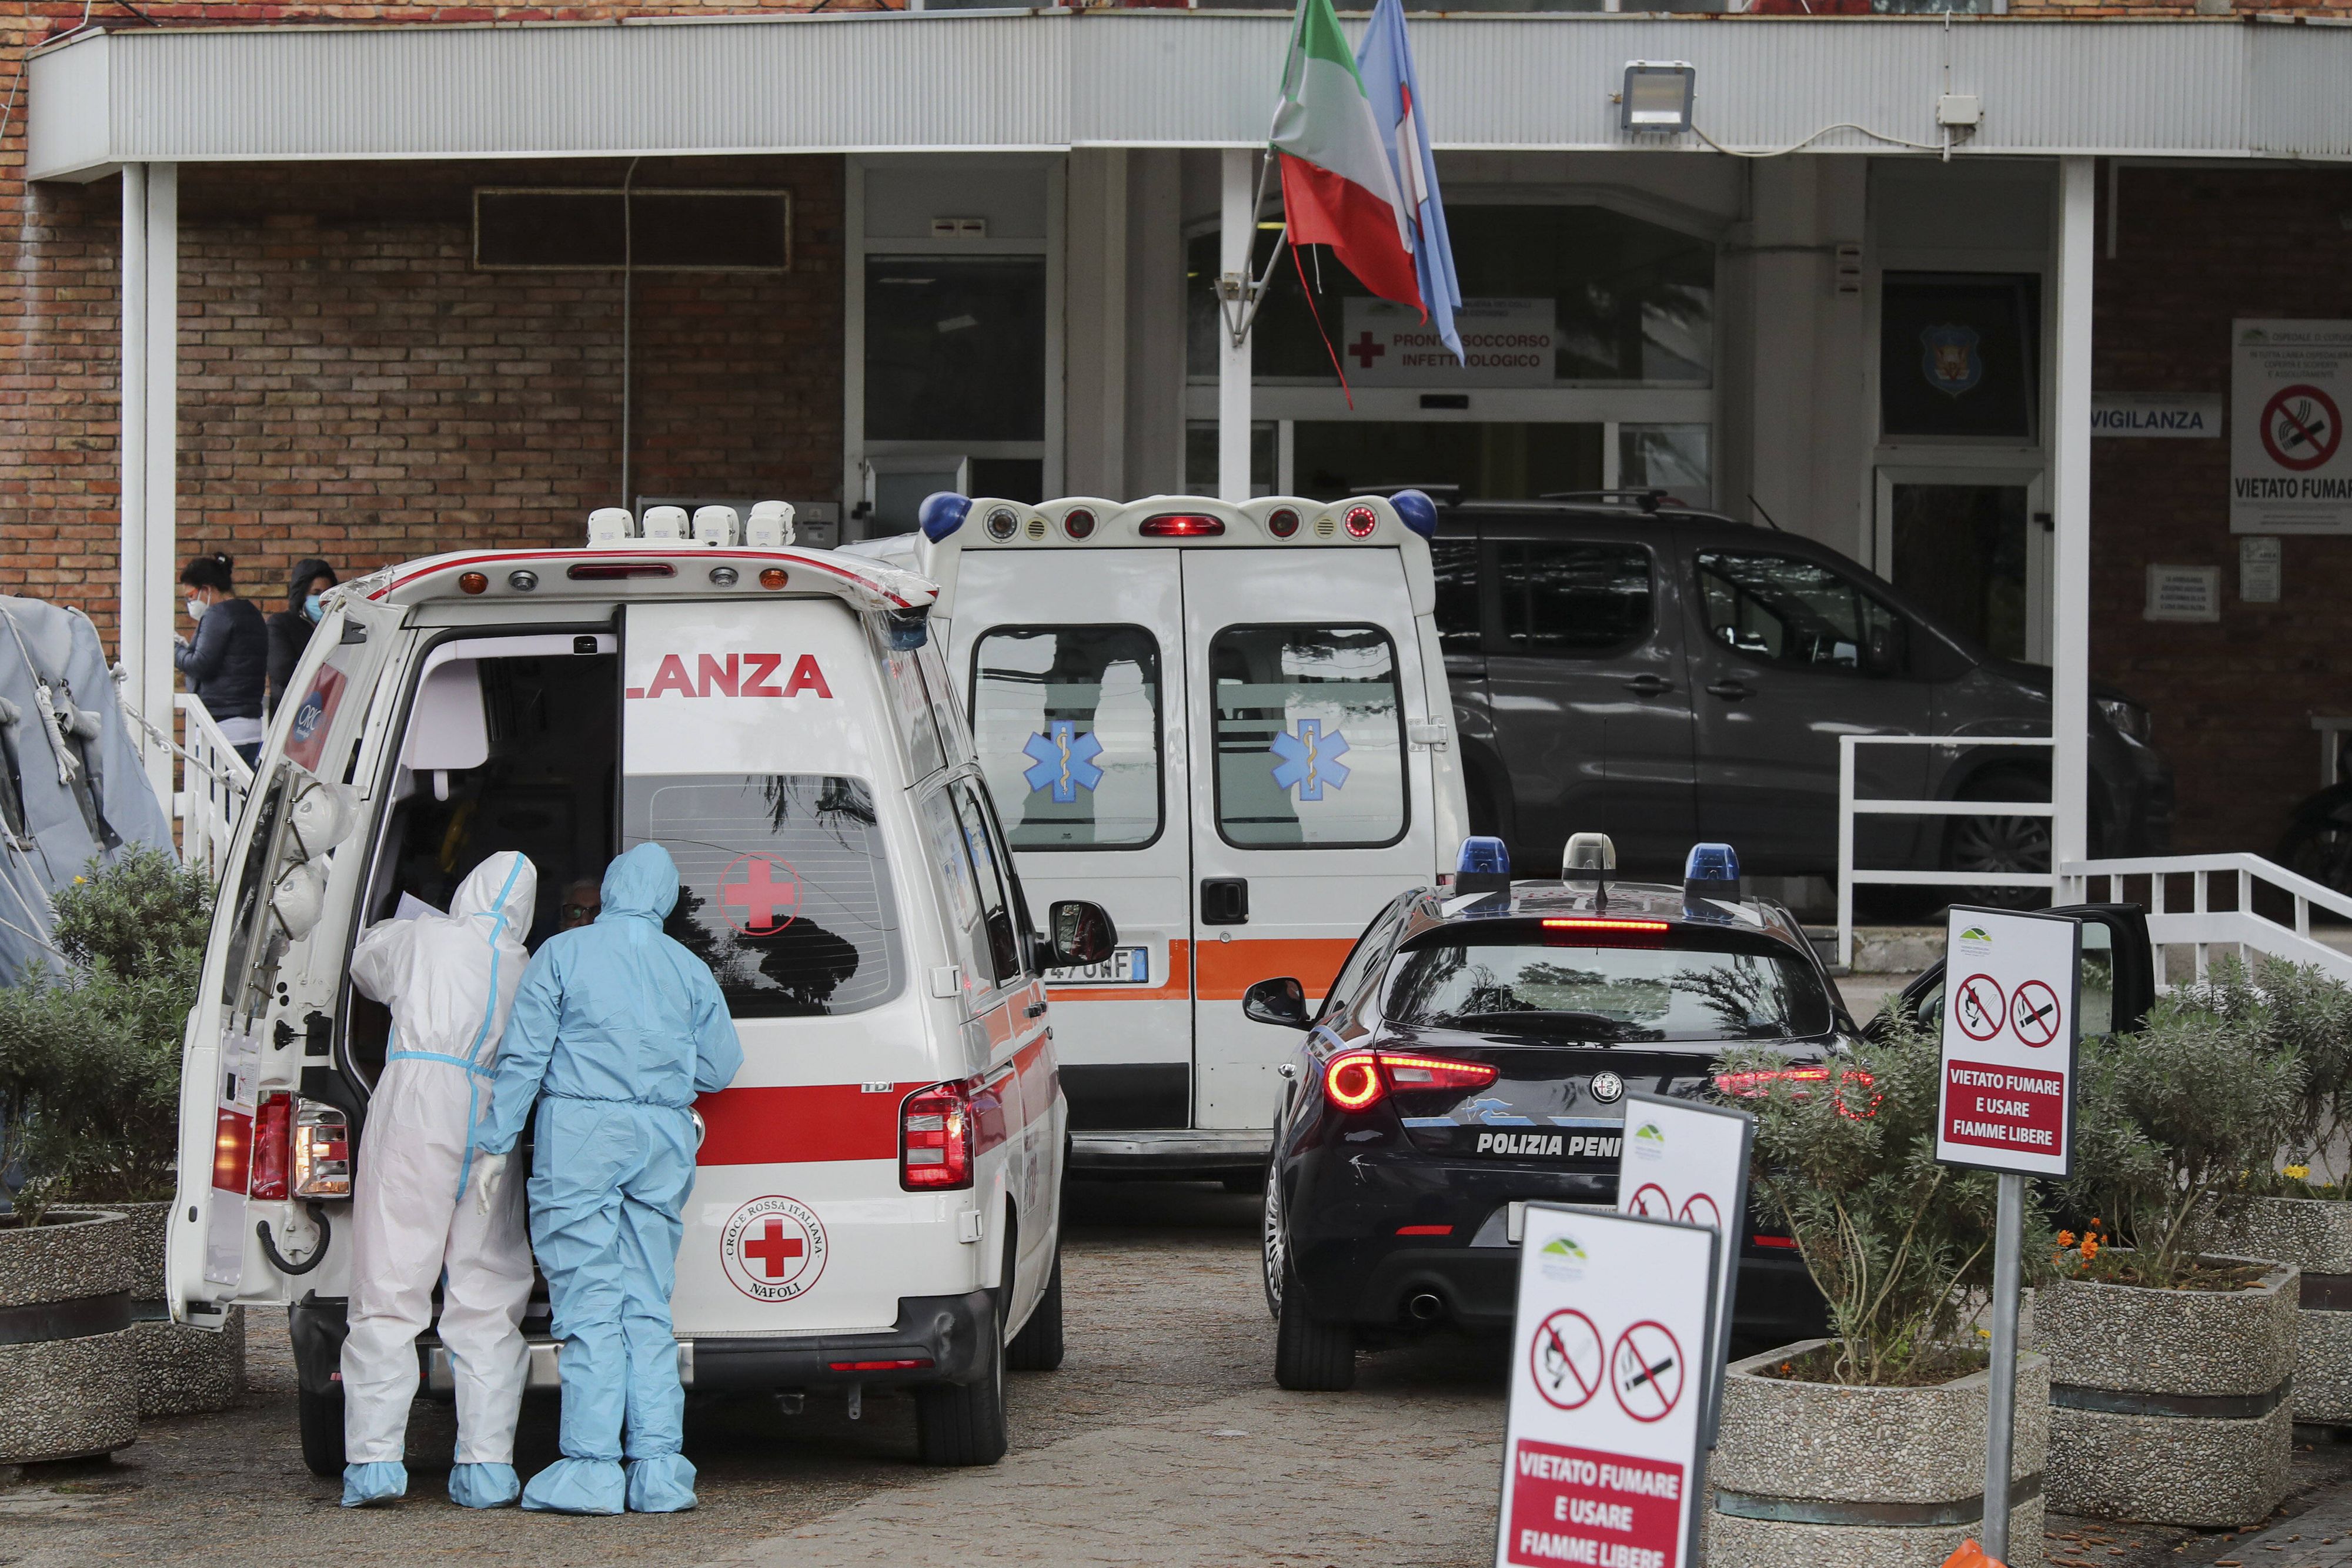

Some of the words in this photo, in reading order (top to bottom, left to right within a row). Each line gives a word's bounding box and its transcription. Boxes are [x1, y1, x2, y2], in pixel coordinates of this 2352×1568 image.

[1393, 334, 1444, 347] PRONT
[1462, 334, 1551, 347] SOCCORSO
[2091, 410, 2204, 429] VIGILANZA
[2235, 478, 2298, 499] VIETATO
[861, 1081, 894, 1093] TDI
[1950, 1068, 2003, 1090] VIETATO
[2006, 1075, 2060, 1096] FUMARE
[1976, 1096, 1984, 1112] E
[1987, 1098, 2030, 1118] USARE
[1953, 1119, 2006, 1141] FIAMME
[2009, 1126, 2053, 1146] LIBERE
[1476, 1133, 1562, 1155] POLIZIA
[747, 1201, 786, 1217] ROSSA
[749, 1282, 801, 1298] NAPOLI
[1519, 1450, 1598, 1486] VIETATO
[1599, 1463, 1679, 1500] FUMARE
[1554, 1495, 1568, 1521] E
[1570, 1498, 1633, 1532] USARE
[1519, 1529, 1599, 1565] FIAMME
